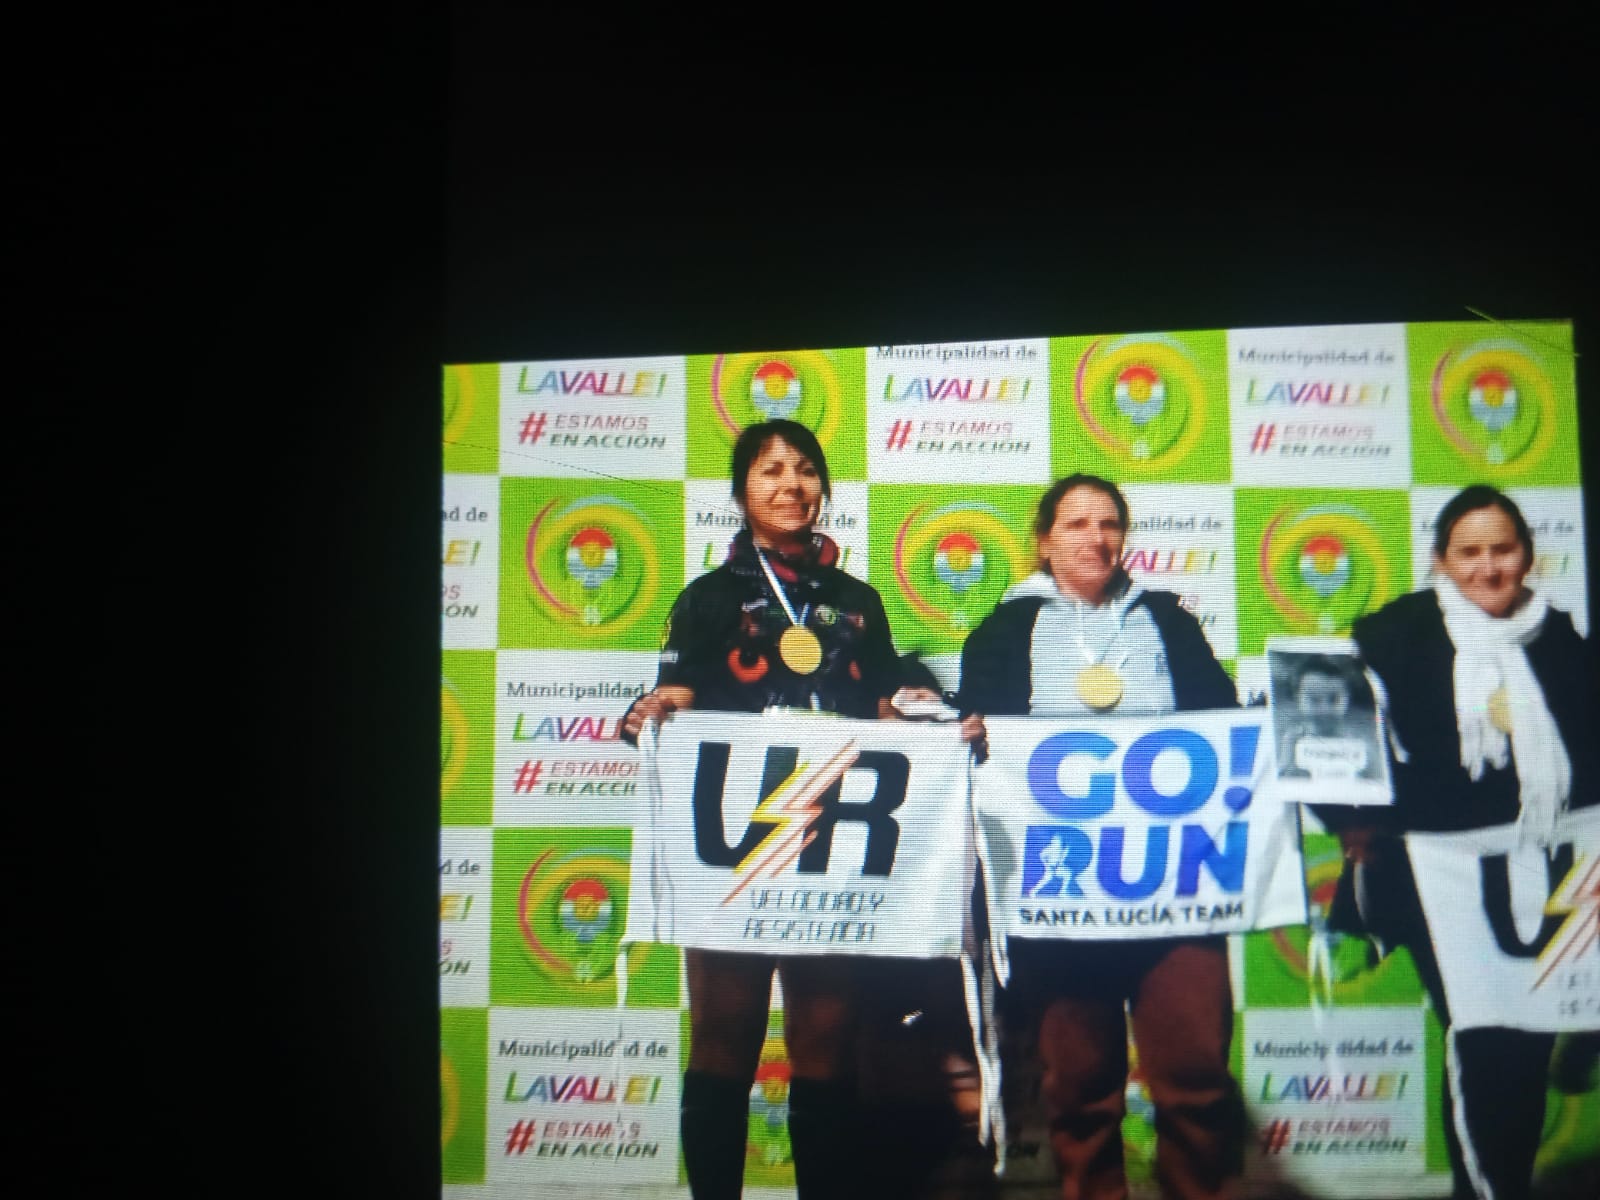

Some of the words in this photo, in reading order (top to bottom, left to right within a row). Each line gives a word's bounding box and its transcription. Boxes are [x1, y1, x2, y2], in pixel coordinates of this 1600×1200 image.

[1017, 345, 1037, 360] de
[554, 414, 648, 430] ESTAMOS
[550, 434, 577, 448] EN
[465, 506, 488, 521] de
[506, 681, 646, 701] Municipalidad
[1027, 725, 1261, 820] GO!
[546, 782, 575, 796] EN
[458, 859, 481, 875] de
[1021, 821, 1249, 901] RUN
[1019, 907, 1095, 926] SANTA
[1104, 902, 1172, 925] LUCÍA
[1180, 900, 1243, 923] TEAM
[645, 1039, 668, 1058] de
[536, 1141, 567, 1158] EN
